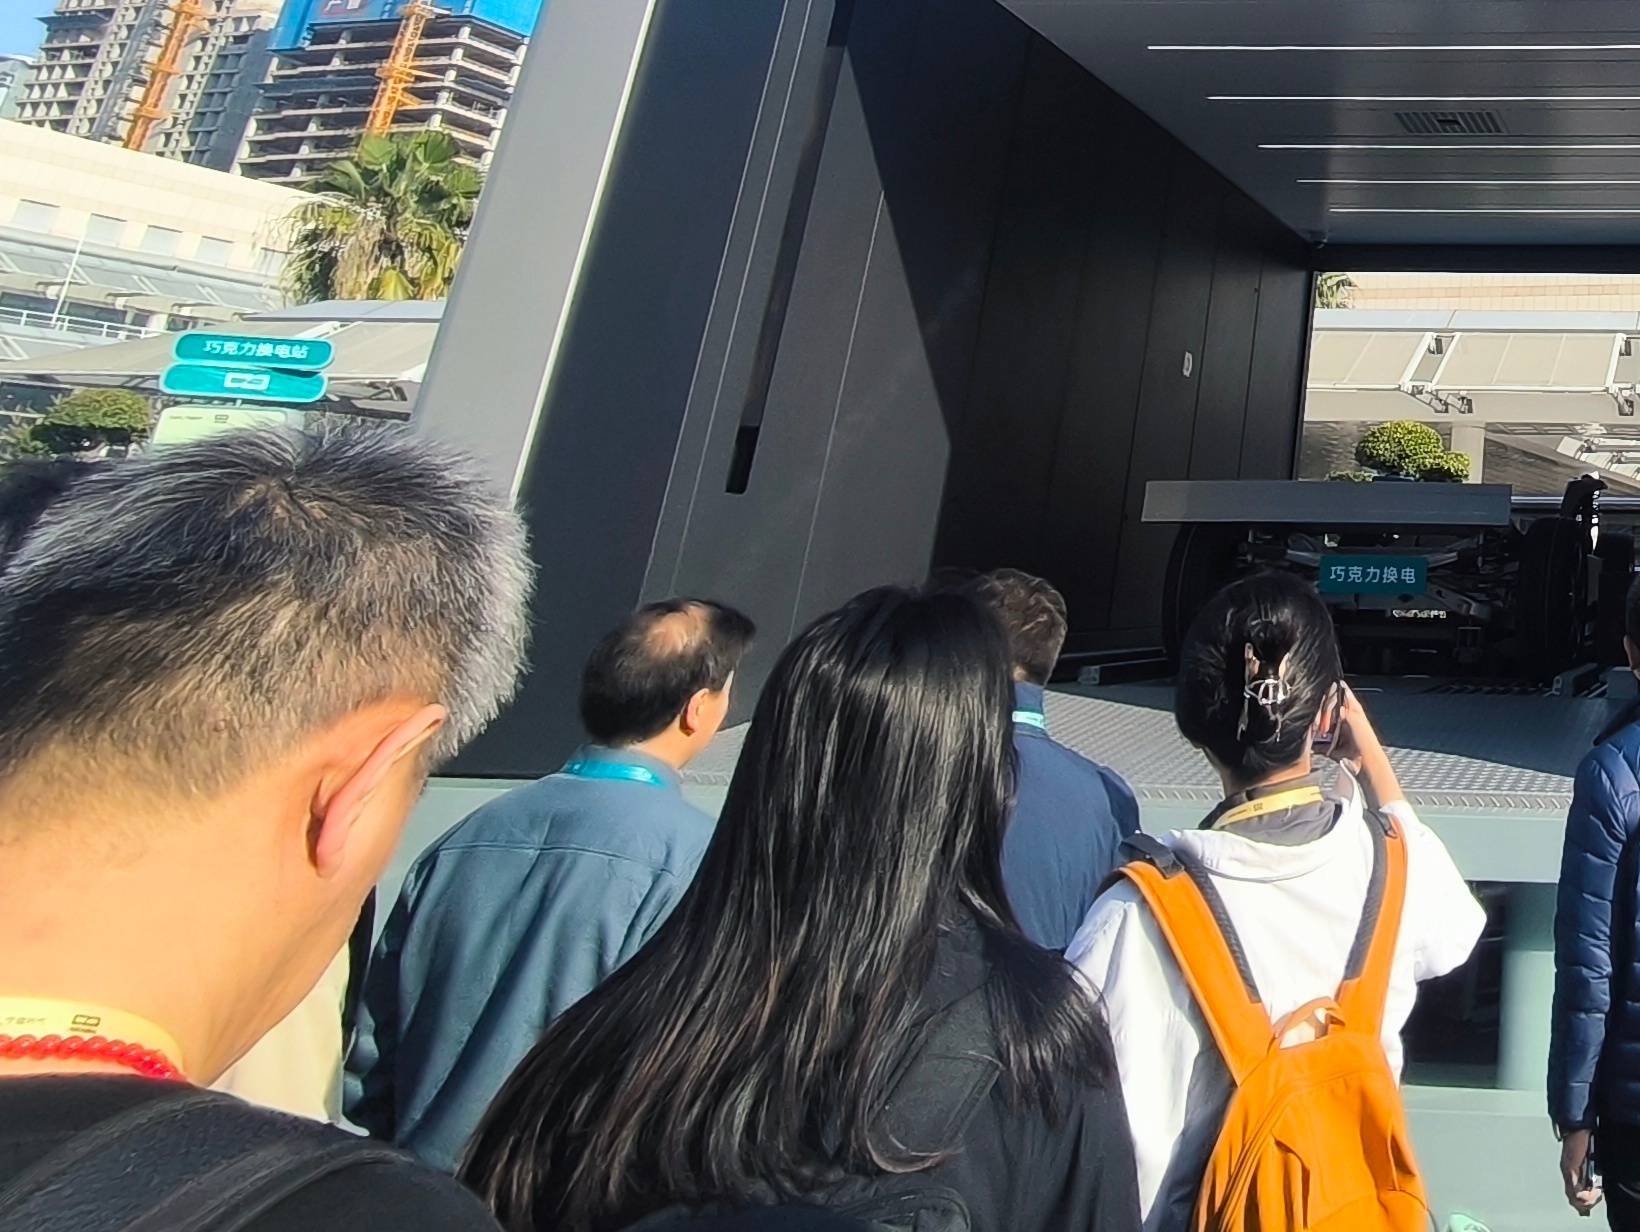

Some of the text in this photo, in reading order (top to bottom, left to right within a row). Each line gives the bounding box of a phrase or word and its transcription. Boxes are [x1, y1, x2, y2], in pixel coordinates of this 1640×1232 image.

[203, 340, 309, 359] 巧克力换电站
[1329, 565, 1417, 584] 巧克力换电
